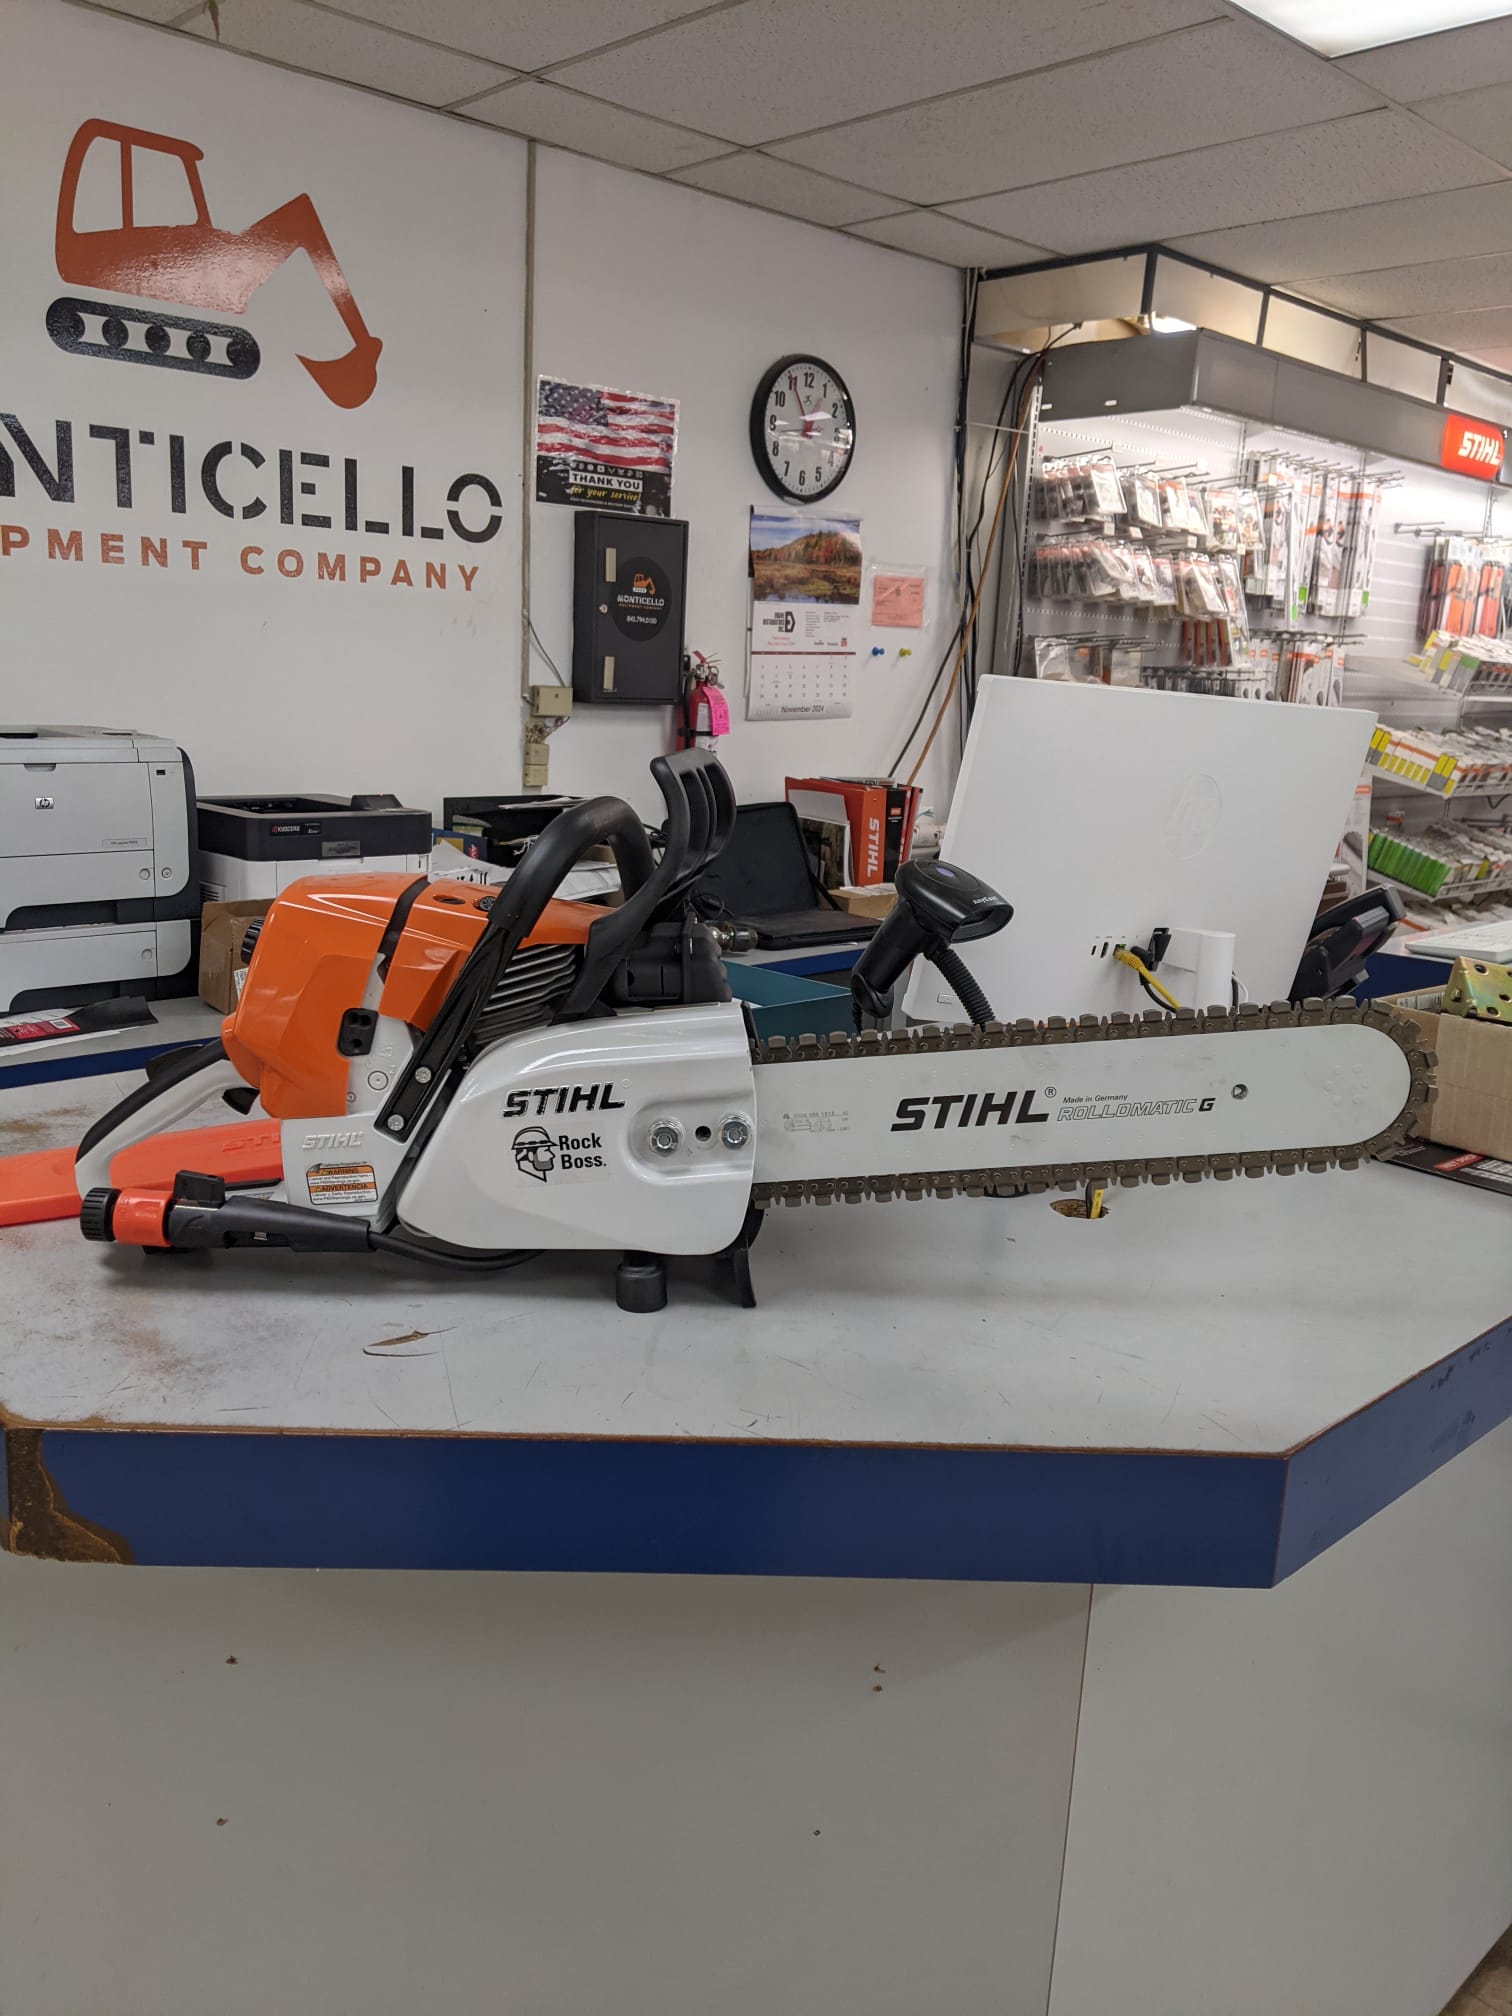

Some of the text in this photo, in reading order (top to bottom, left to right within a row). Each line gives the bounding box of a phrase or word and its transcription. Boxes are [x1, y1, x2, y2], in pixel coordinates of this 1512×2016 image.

[804, 371, 815, 388] 12
[774, 390, 786, 407] 10
[822, 383, 828, 398] 1
[832, 402, 838, 418] 2
[770, 414, 776, 431] 9
[772, 441, 779, 456] 8
[1458, 431, 1500, 465] STIHL
[827, 451, 834, 467] 4
[784, 460, 790, 477] 7
[815, 466, 822, 482] 5
[573, 473, 640, 490] THANK YOU
[798, 470, 806, 486] 6
[587, 488, 608, 498] your
[0, 524, 479, 592] PMENT COMPANY
[617, 594, 664, 606] MONTICELLO
[781, 705, 811, 713] November
[866, 817, 880, 878] STIHL
[503, 1081, 626, 1118] STIHL
[1063, 1096, 1084, 1104] Made
[1094, 1094, 1128, 1103] Germany
[890, 1090, 1049, 1132] STIHL
[1057, 1098, 1216, 1122] ROLLOMATIC G
[302, 1132, 362, 1150] STIHL
[558, 1132, 603, 1151] Rock
